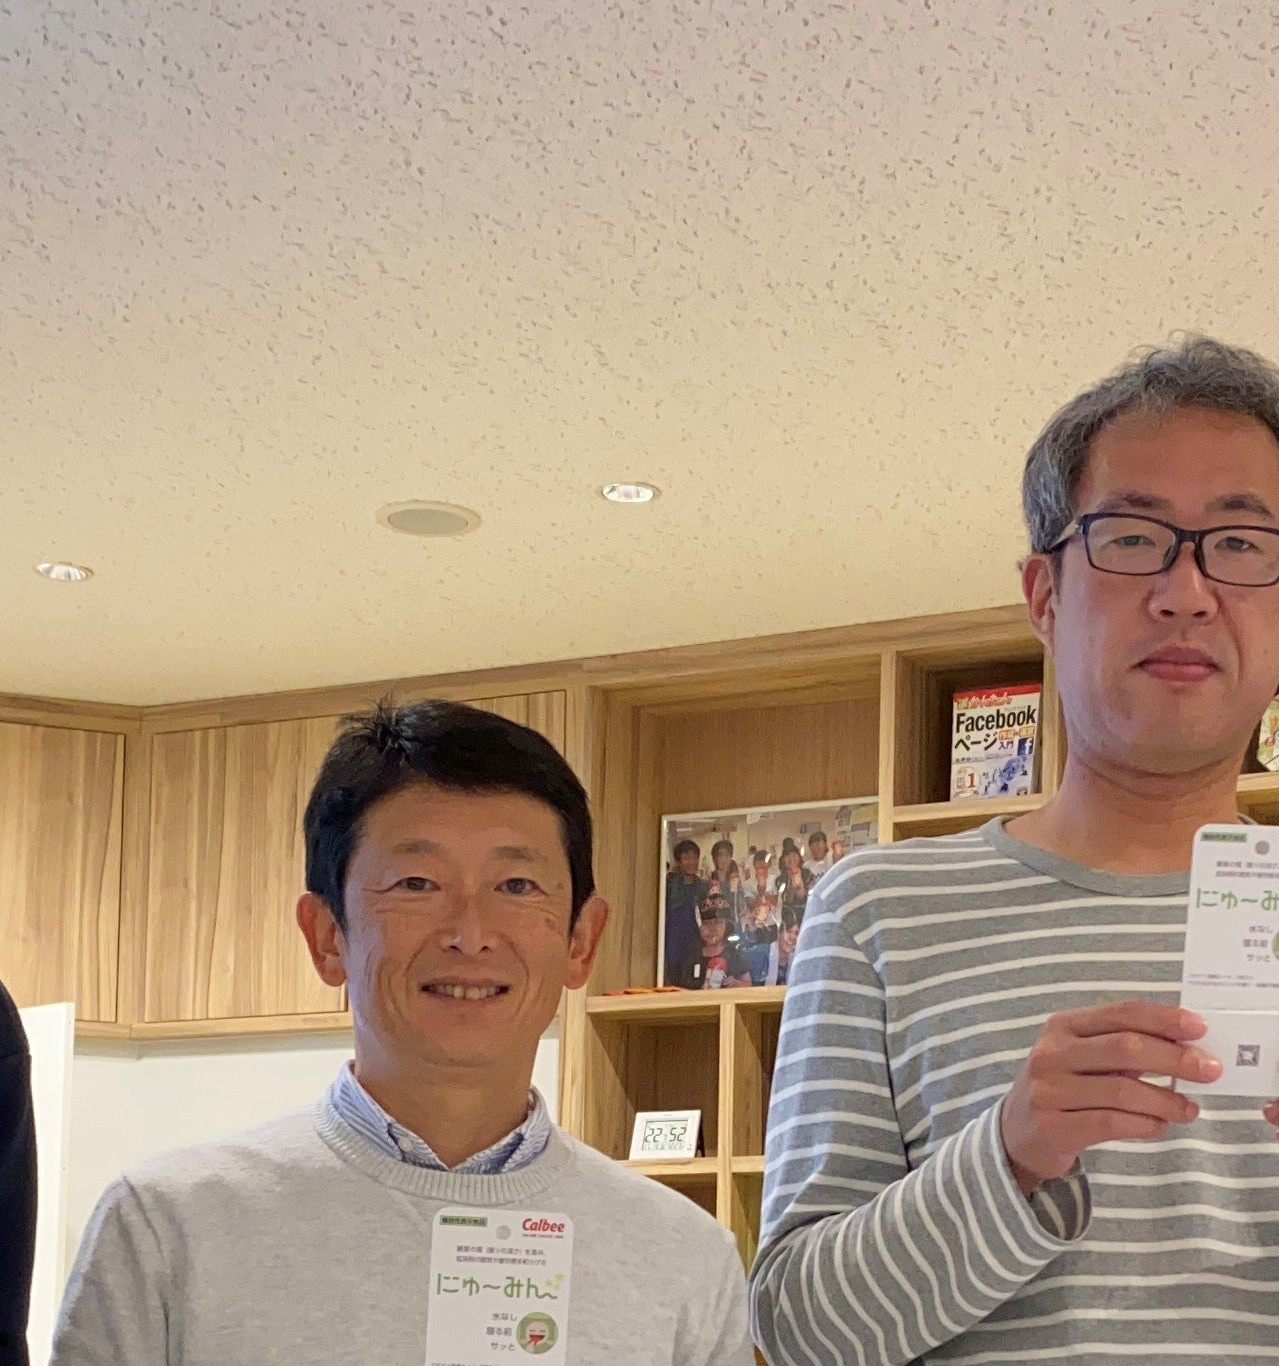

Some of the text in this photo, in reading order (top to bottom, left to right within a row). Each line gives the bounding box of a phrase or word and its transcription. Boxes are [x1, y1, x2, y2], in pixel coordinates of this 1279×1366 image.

[956, 705, 1036, 733] Facebook
[954, 731, 998, 751] ページ
[522, 1218, 565, 1232] Calbee
